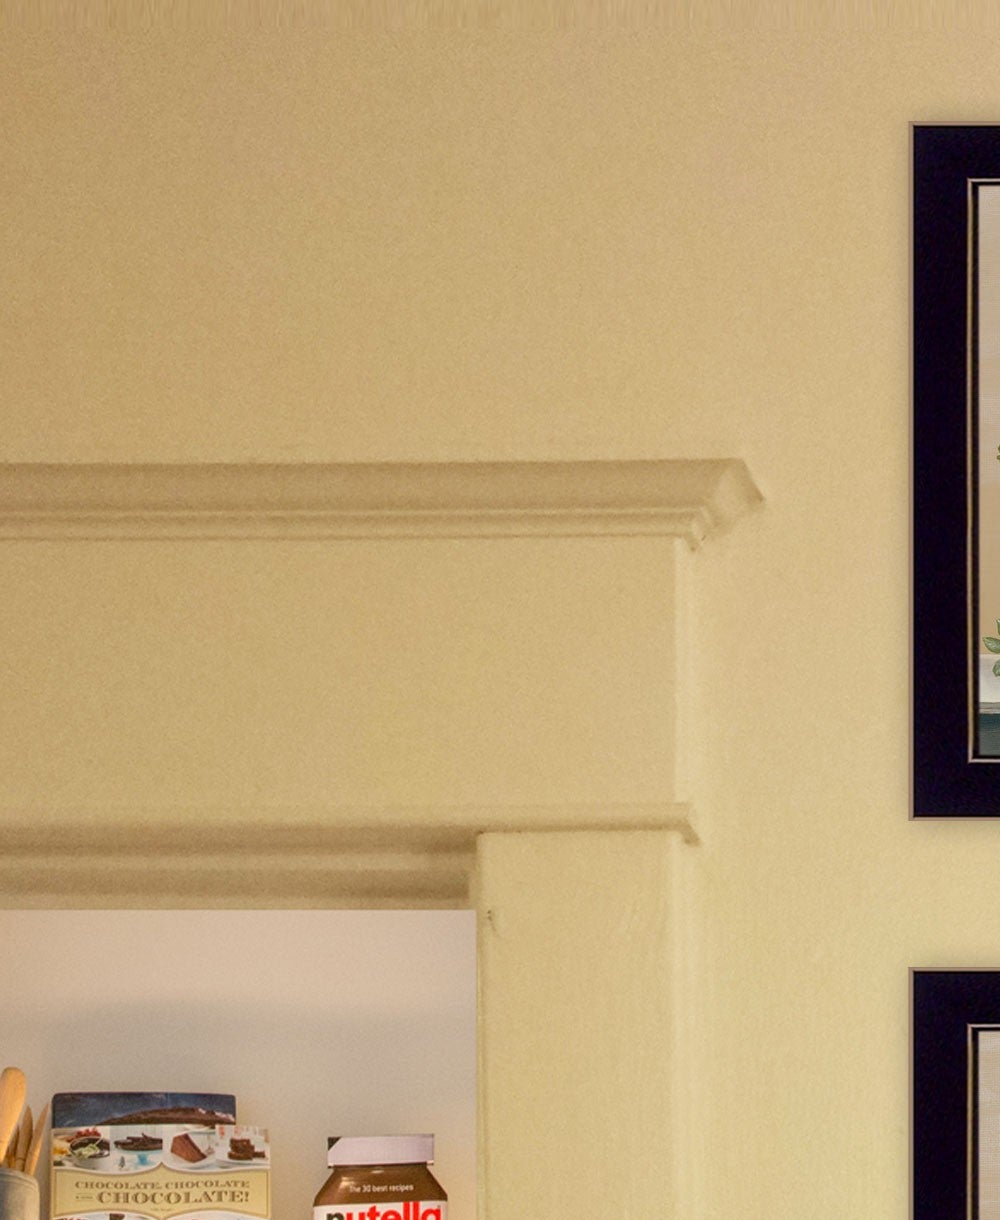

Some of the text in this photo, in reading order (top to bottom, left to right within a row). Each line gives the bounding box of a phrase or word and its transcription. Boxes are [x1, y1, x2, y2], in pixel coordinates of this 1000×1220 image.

[165, 1180, 250, 1189] CHOCOLATE
[372, 1184, 387, 1192] best
[388, 1184, 414, 1192] recipes
[97, 1190, 250, 1205] CHOCOLATE!
